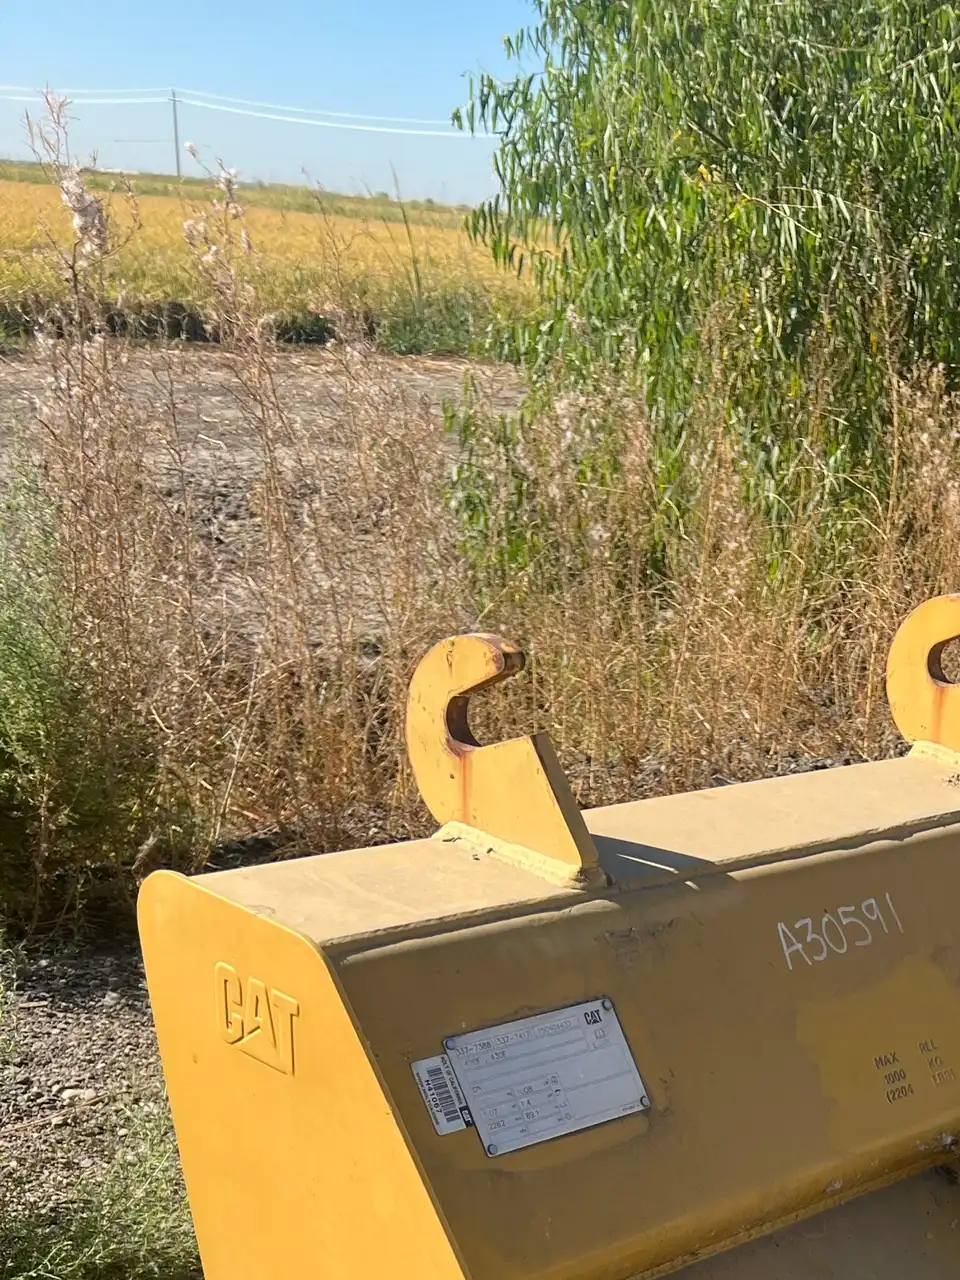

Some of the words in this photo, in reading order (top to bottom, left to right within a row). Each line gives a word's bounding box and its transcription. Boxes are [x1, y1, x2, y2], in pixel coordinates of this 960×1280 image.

[777, 892, 904, 970] A30591
[213, 960, 299, 1077] CAT
[584, 1009, 603, 1025] CAT
[874, 1051, 899, 1070] MAX
[884, 1068, 906, 1084] 1000
[424, 1079, 443, 1113] H41067
